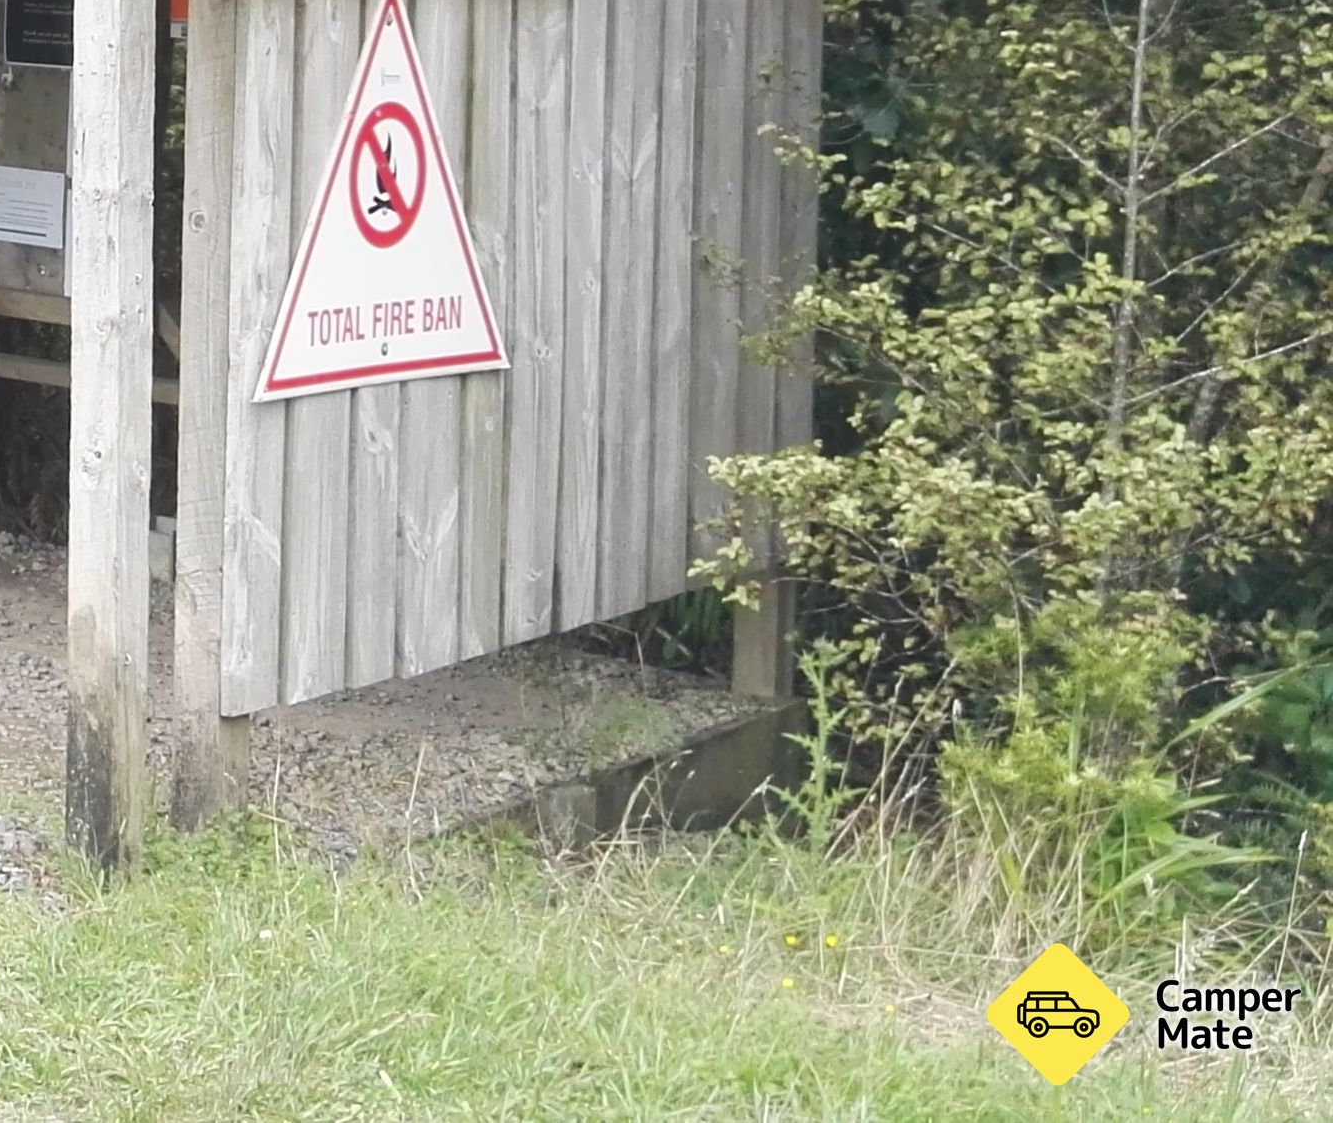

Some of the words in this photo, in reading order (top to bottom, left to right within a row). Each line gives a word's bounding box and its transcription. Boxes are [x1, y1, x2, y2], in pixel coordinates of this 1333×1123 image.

[307, 305, 366, 347] TOTAL
[372, 299, 415, 339] FIRE
[422, 294, 463, 332] BAN
